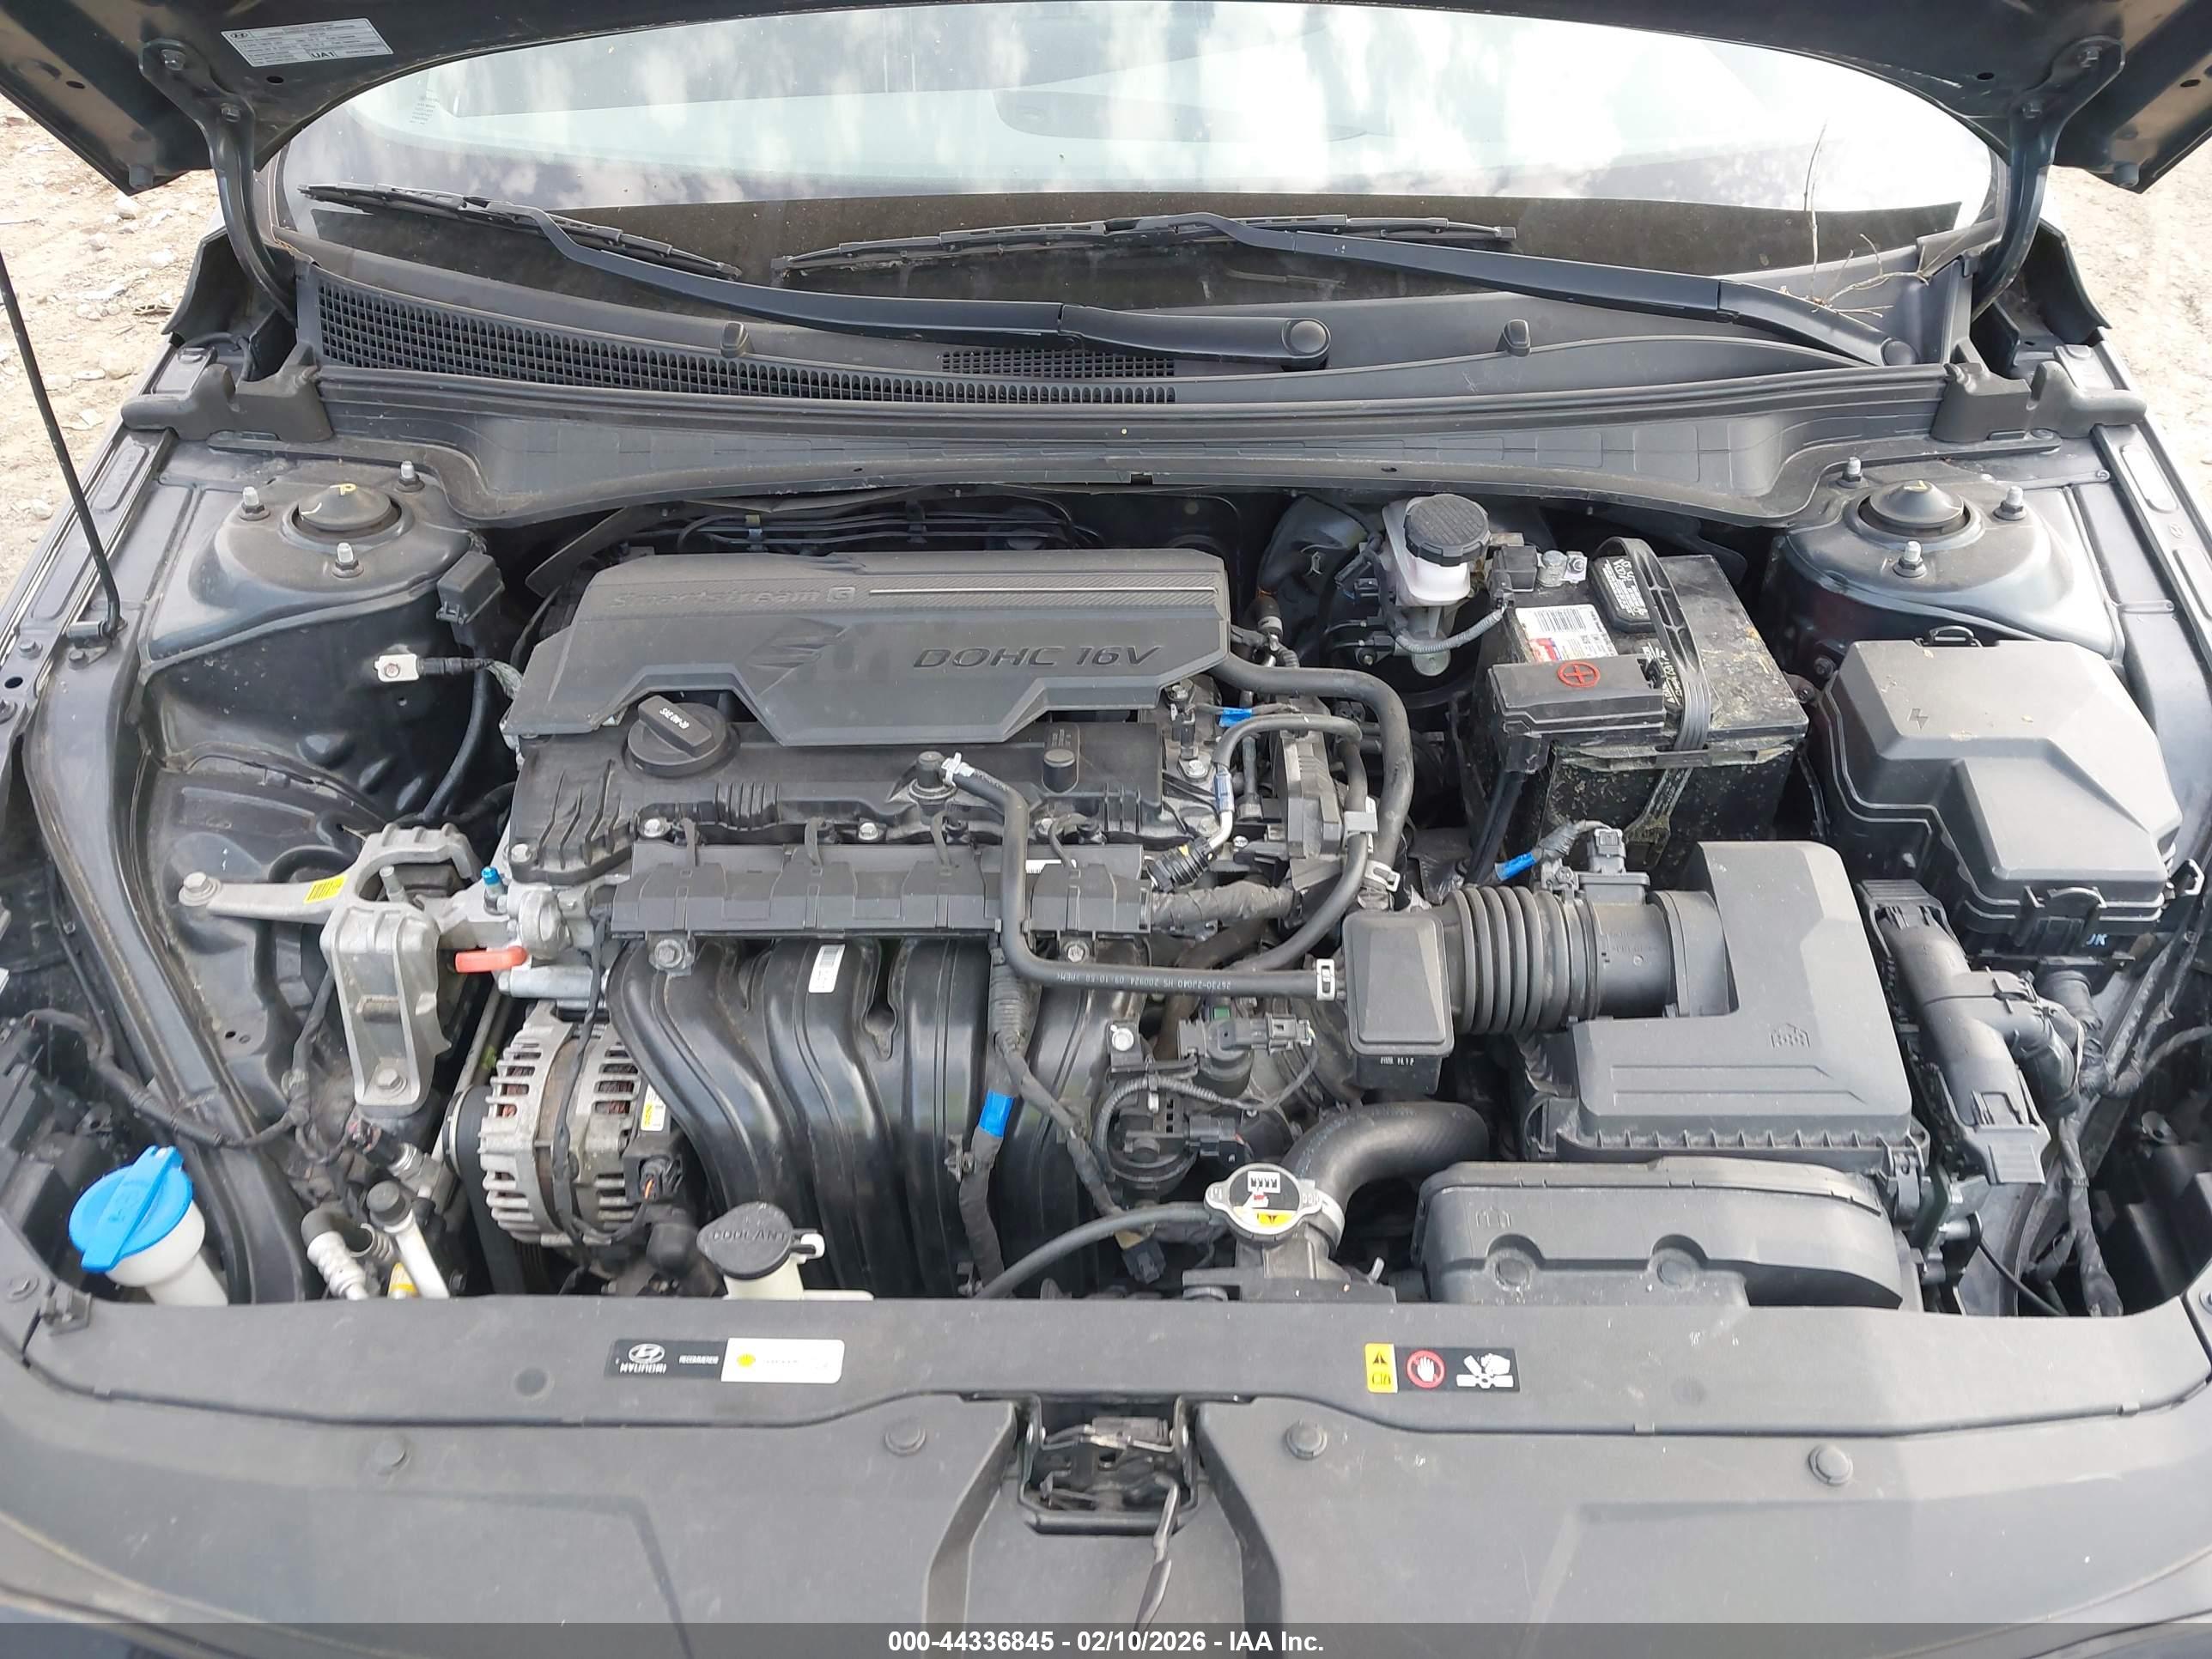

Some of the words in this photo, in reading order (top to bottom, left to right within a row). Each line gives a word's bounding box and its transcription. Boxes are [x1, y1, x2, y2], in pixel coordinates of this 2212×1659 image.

[311, 50, 335, 58] UA1
[913, 647, 1064, 668] DOHC
[1075, 646, 1162, 665] 16V
[713, 1229, 786, 1242] COOLANT
